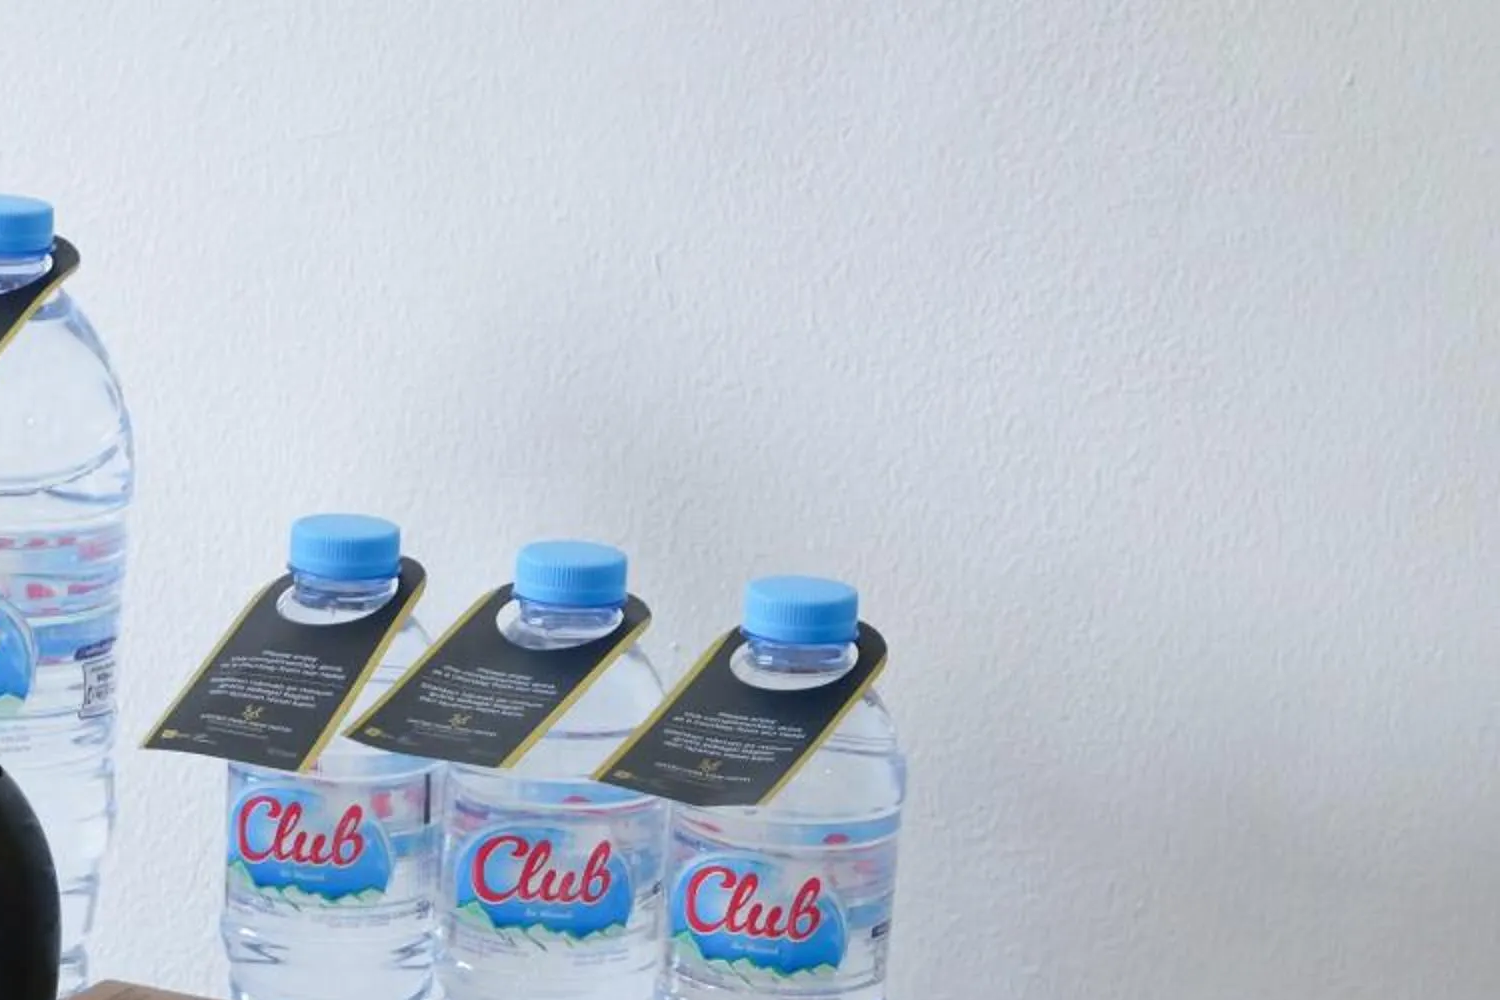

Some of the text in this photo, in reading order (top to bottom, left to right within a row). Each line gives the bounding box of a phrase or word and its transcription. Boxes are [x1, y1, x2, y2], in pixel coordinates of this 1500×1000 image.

[238, 795, 364, 866] Club
[472, 835, 613, 904] Club
[685, 866, 822, 940] Club
